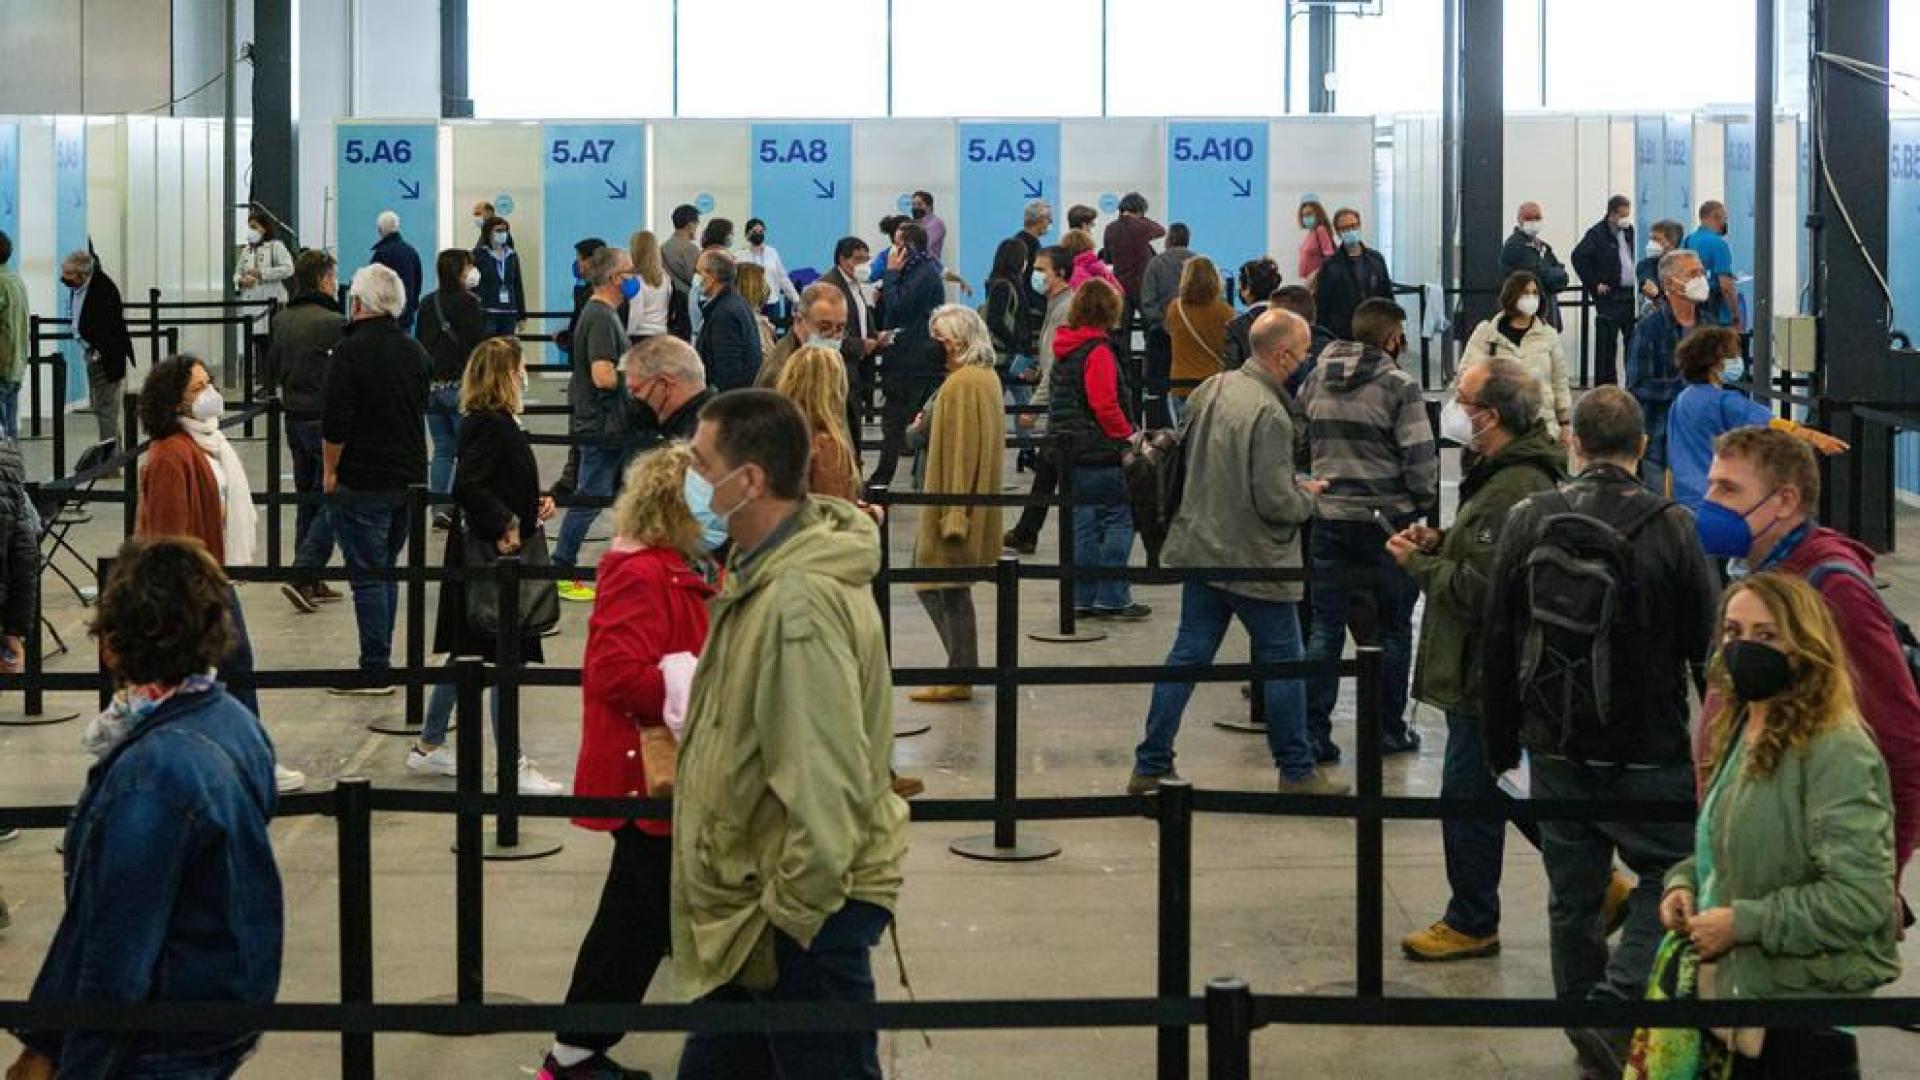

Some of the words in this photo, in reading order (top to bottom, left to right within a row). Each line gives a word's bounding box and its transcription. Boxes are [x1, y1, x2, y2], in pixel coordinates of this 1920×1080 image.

[345, 140, 411, 163] 5.A6
[552, 140, 615, 163] 5.A7
[759, 140, 828, 163] 5.A8
[968, 139, 1035, 162] 5.A9
[1174, 138, 1254, 162] 5.A10
[1664, 138, 1686, 165] 5.B2
